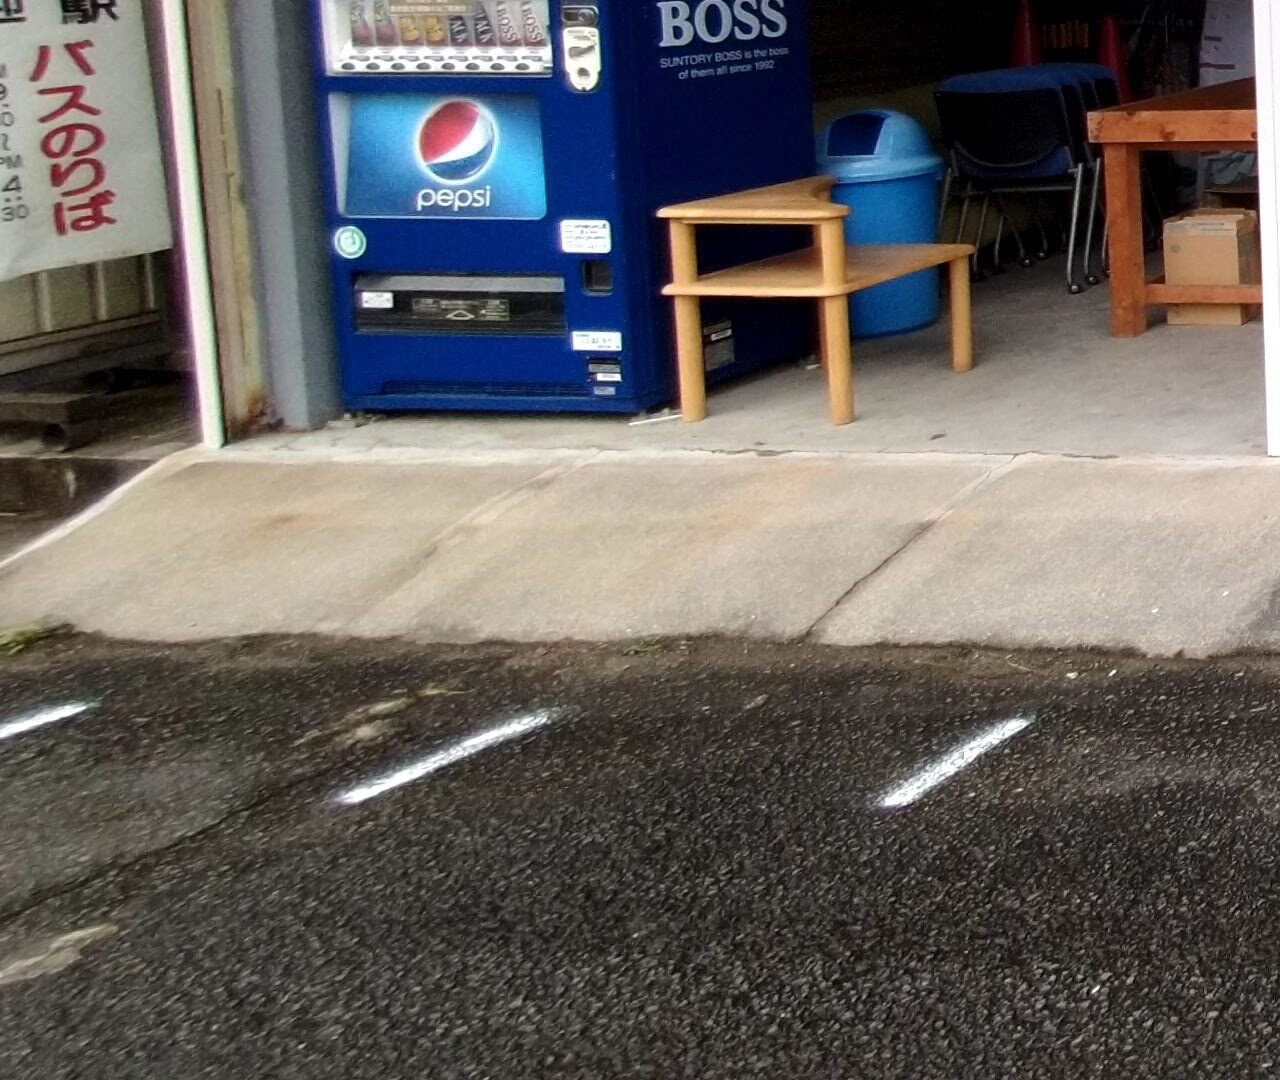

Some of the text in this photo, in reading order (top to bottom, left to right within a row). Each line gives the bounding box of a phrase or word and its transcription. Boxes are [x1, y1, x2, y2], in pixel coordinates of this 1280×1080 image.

[660, 53, 713, 69] SUNTORY
[714, 50, 742, 63] BOSS
[754, 59, 775, 71] 1992
[29, 39, 117, 236] バスのりば
[416, 184, 492, 212] pepsi
